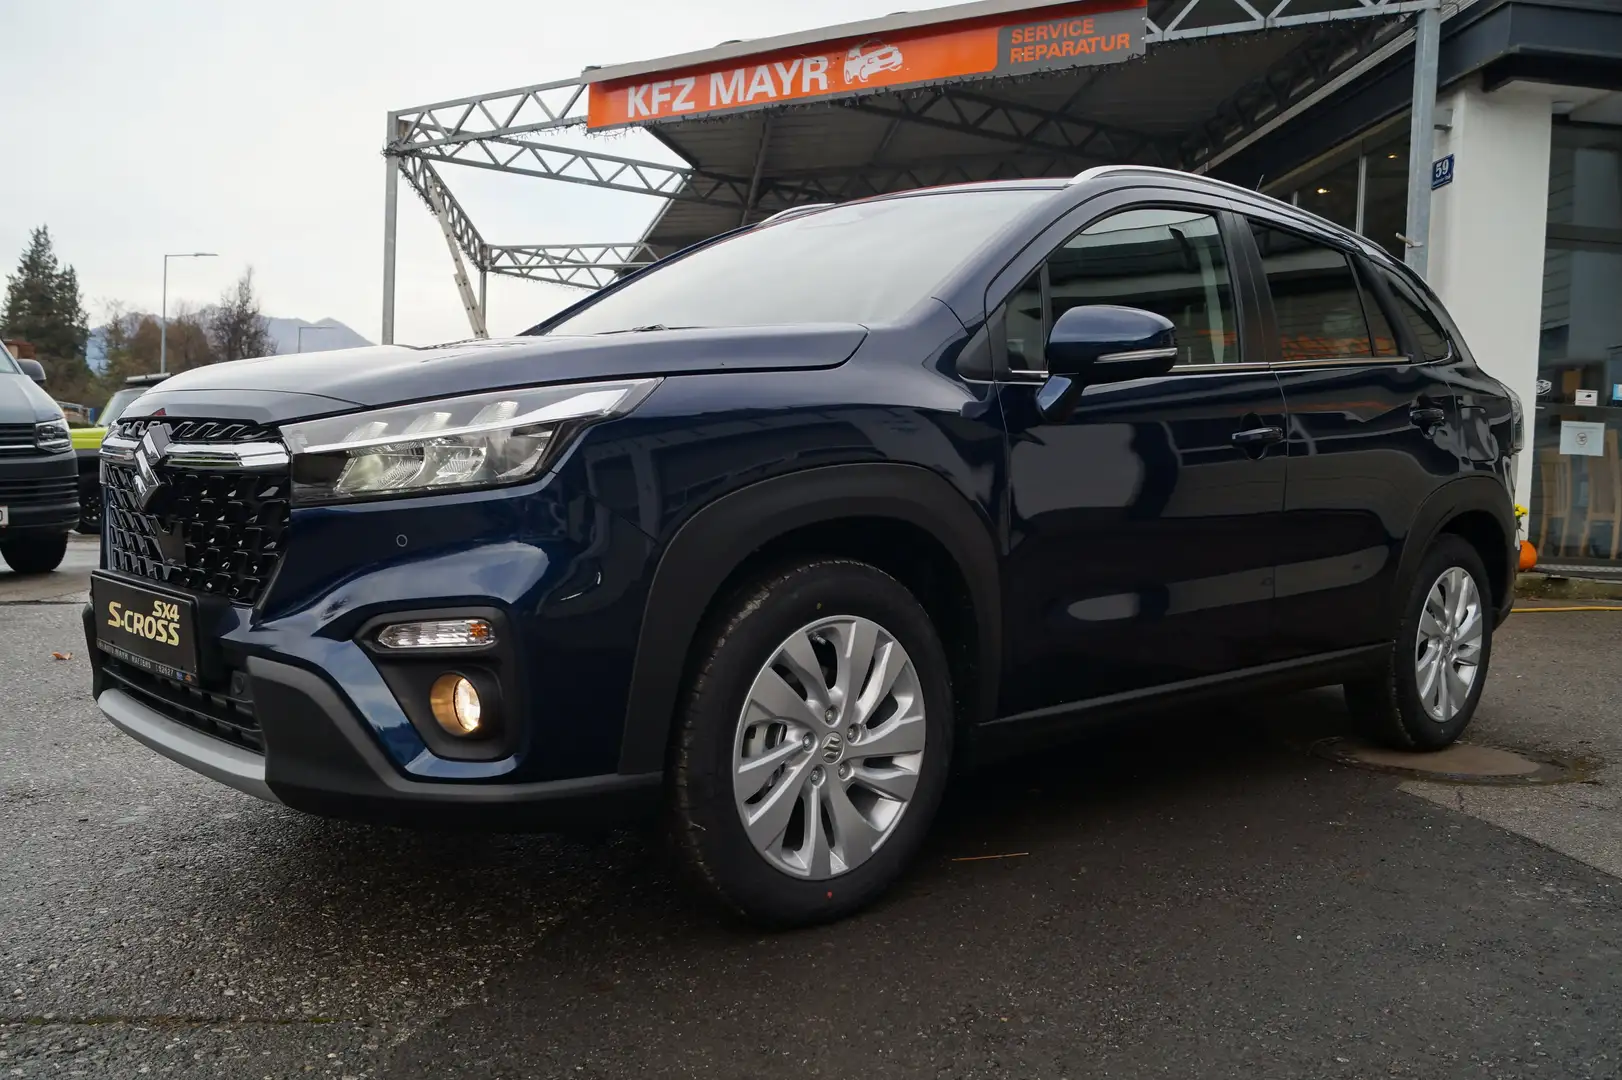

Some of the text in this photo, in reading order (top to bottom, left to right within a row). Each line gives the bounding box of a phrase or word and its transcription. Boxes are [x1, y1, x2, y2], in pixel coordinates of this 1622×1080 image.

[1011, 18, 1095, 45] SERVICE
[1010, 33, 1131, 64] REPARATUR
[627, 55, 829, 118] KFZ MAYR
[1435, 159, 1449, 178] 59
[152, 600, 180, 622] SX4
